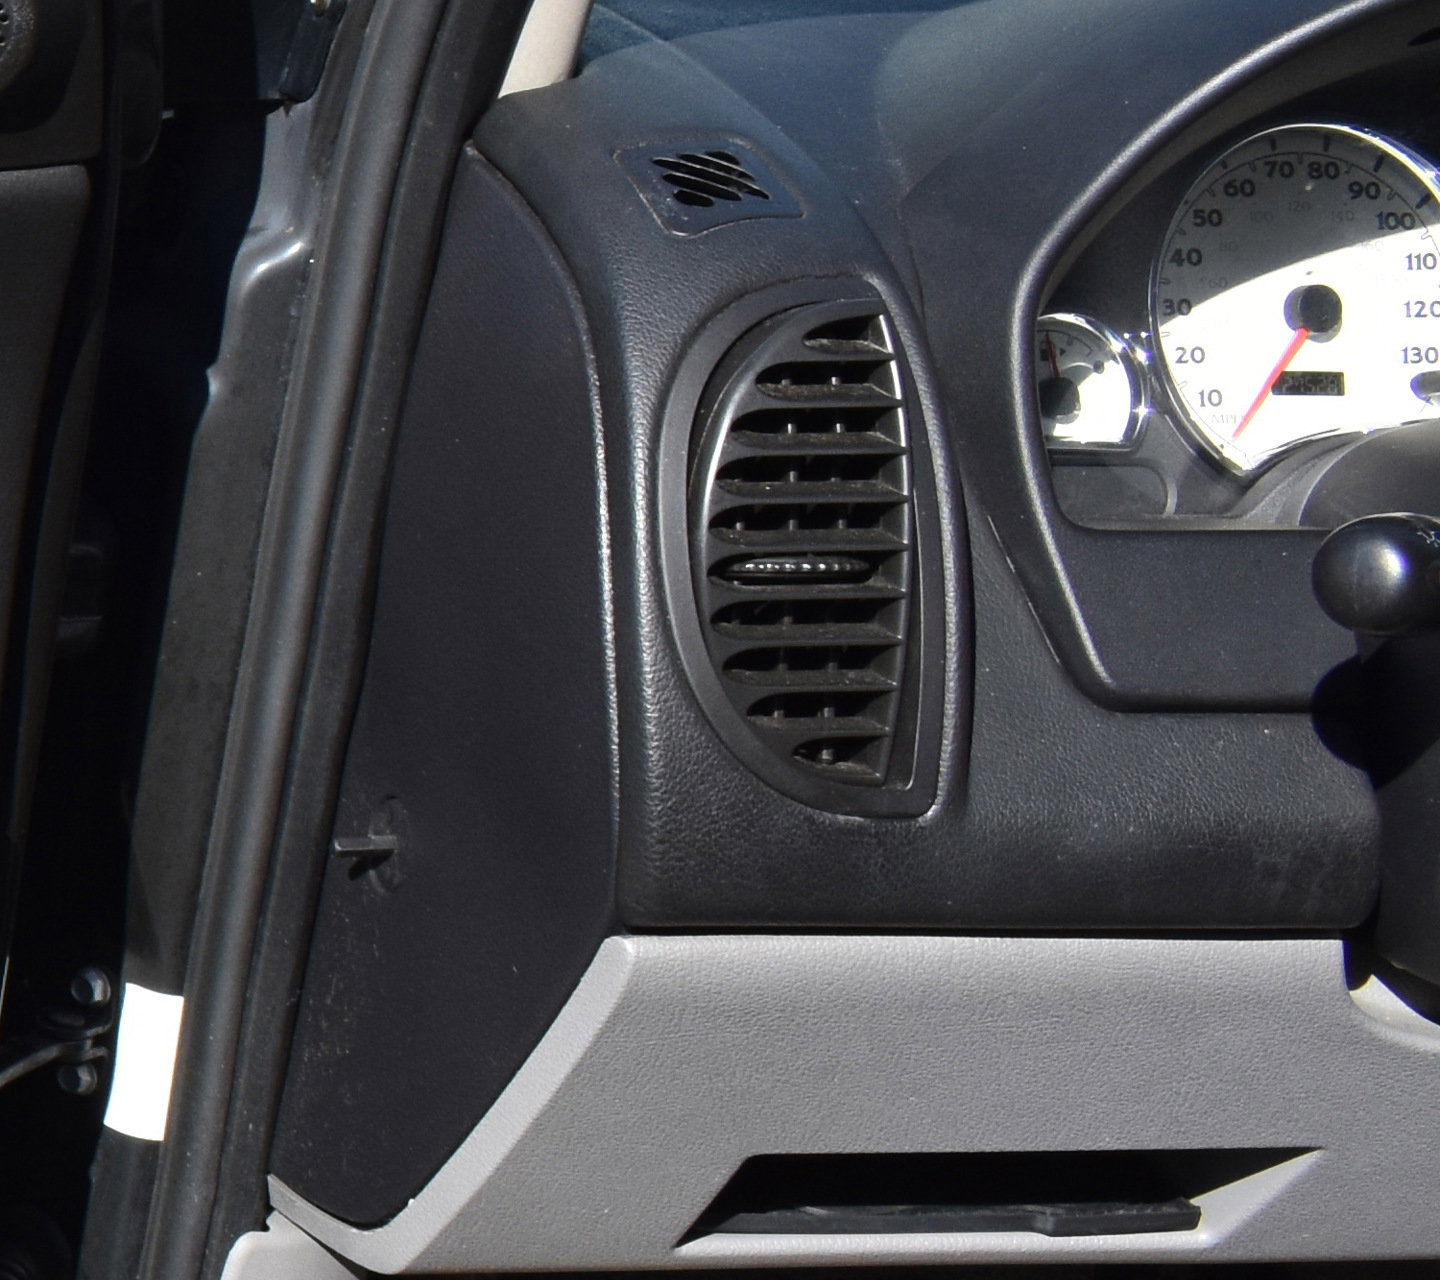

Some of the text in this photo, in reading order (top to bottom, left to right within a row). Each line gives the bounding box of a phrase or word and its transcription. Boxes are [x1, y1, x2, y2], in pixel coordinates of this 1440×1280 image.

[1264, 161, 1294, 179] 70
[1308, 162, 1340, 179] 80
[1224, 180, 1256, 197] 60
[1348, 182, 1381, 200] 90
[1193, 209, 1223, 227] 50
[1376, 212, 1415, 230] 100
[1170, 248, 1202, 267] 40
[1405, 253, 1437, 270] 110
[1163, 299, 1192, 316] 30
[1403, 301, 1440, 318] 120
[1175, 347, 1205, 363] 20
[1401, 347, 1438, 364] 130
[1198, 389, 1222, 407] 10
